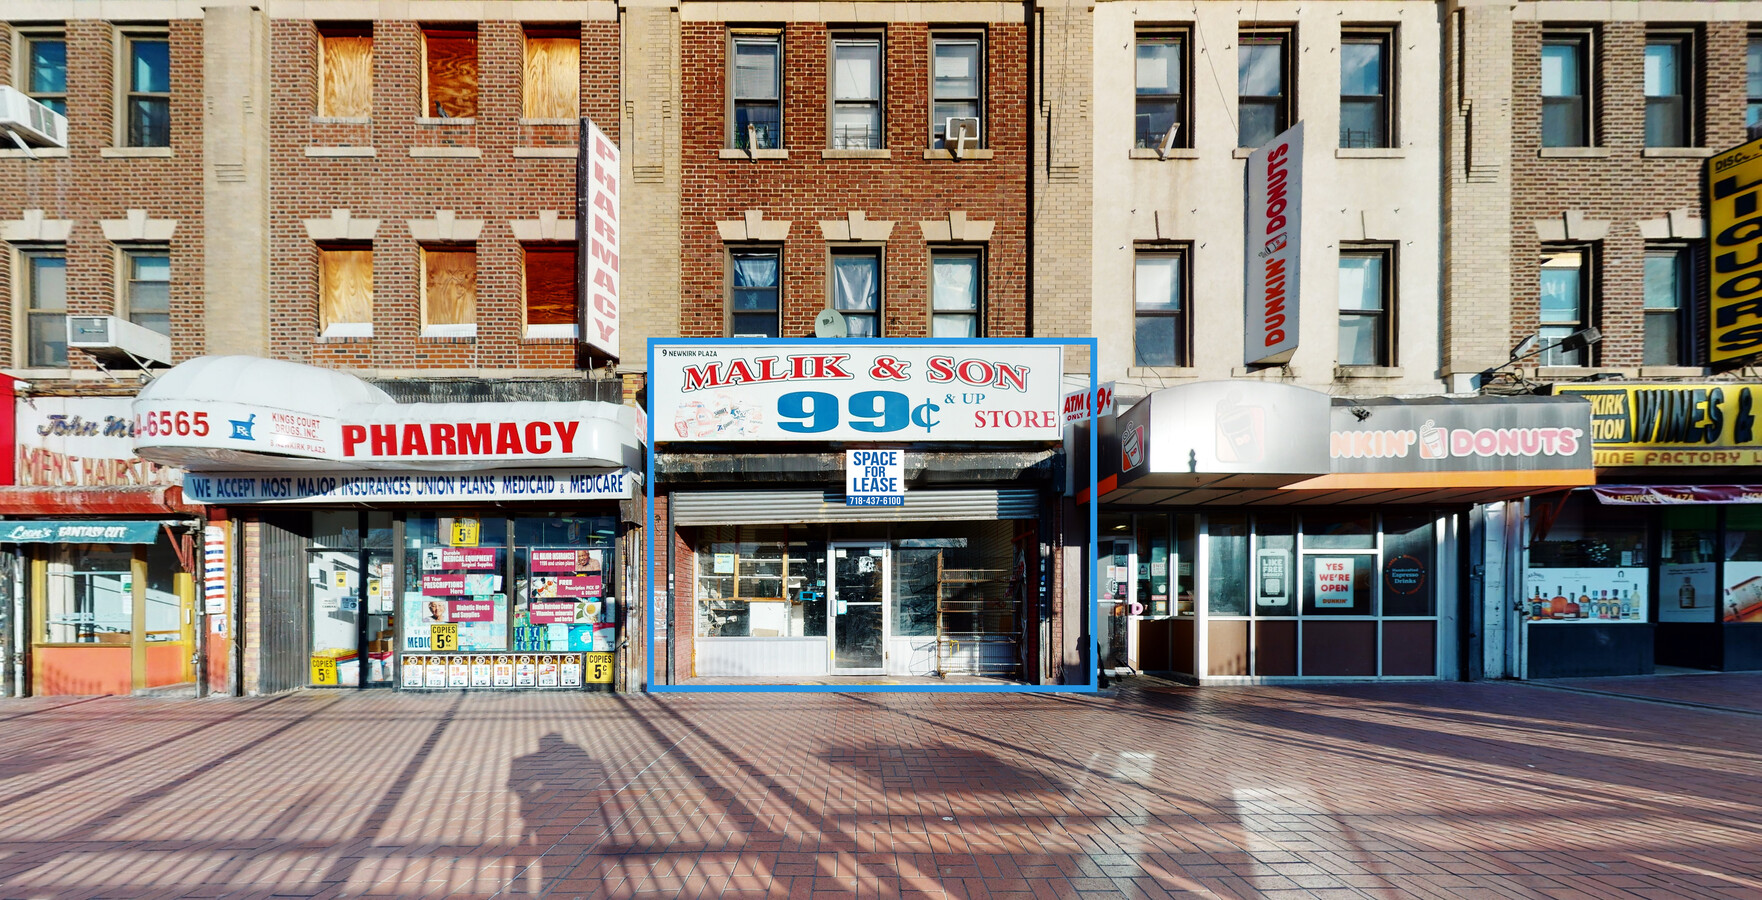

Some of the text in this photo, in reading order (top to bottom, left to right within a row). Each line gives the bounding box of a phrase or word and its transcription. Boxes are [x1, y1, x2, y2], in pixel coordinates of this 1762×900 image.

[592, 135, 619, 343] PHARMACY
[1265, 143, 1289, 347] DUNKIN' DONUTS
[662, 349, 668, 357] 9
[682, 354, 1030, 392] MALIK & SON
[944, 393, 985, 404] & UP
[1063, 393, 1084, 414] ATM
[1582, 394, 1625, 415] KIRK
[777, 390, 941, 433] 99¢
[1067, 412, 1083, 421] ONLY
[1633, 387, 1755, 444] WINES &
[36, 414, 100, 437] John
[271, 412, 320, 429] KINGS COURT
[974, 409, 1057, 430] STORE
[341, 421, 579, 457] PHARMACY
[1450, 427, 1579, 457] DONUTS
[306, 444, 326, 454] PLAZA
[853, 451, 897, 466] SPACE
[1645, 452, 1741, 464] FACTORY
[865, 466, 885, 477] FOR
[192, 478, 210, 498] WE
[216, 478, 256, 498] ACCEPT
[261, 477, 292, 497] MOST
[297, 477, 336, 496] MAJOR
[416, 476, 454, 495] UNION
[502, 475, 555, 494] MEDICAID
[560, 482, 564, 493] &
[569, 474, 623, 493] MEDICARE
[853, 477, 897, 492] LEASE
[850, 496, 901, 505] 718-437-6100
[1617, 494, 1656, 503] NEWKIR
[465, 554, 493, 562] EQUIPMENT
[1319, 573, 1350, 581] WE'RE
[423, 581, 463, 589] PRESCRIPTIONS
[1320, 584, 1349, 592] OPEN
[432, 626, 456, 634] COPIES
[312, 659, 333, 668] COPIES
[589, 655, 612, 664] COPIES
